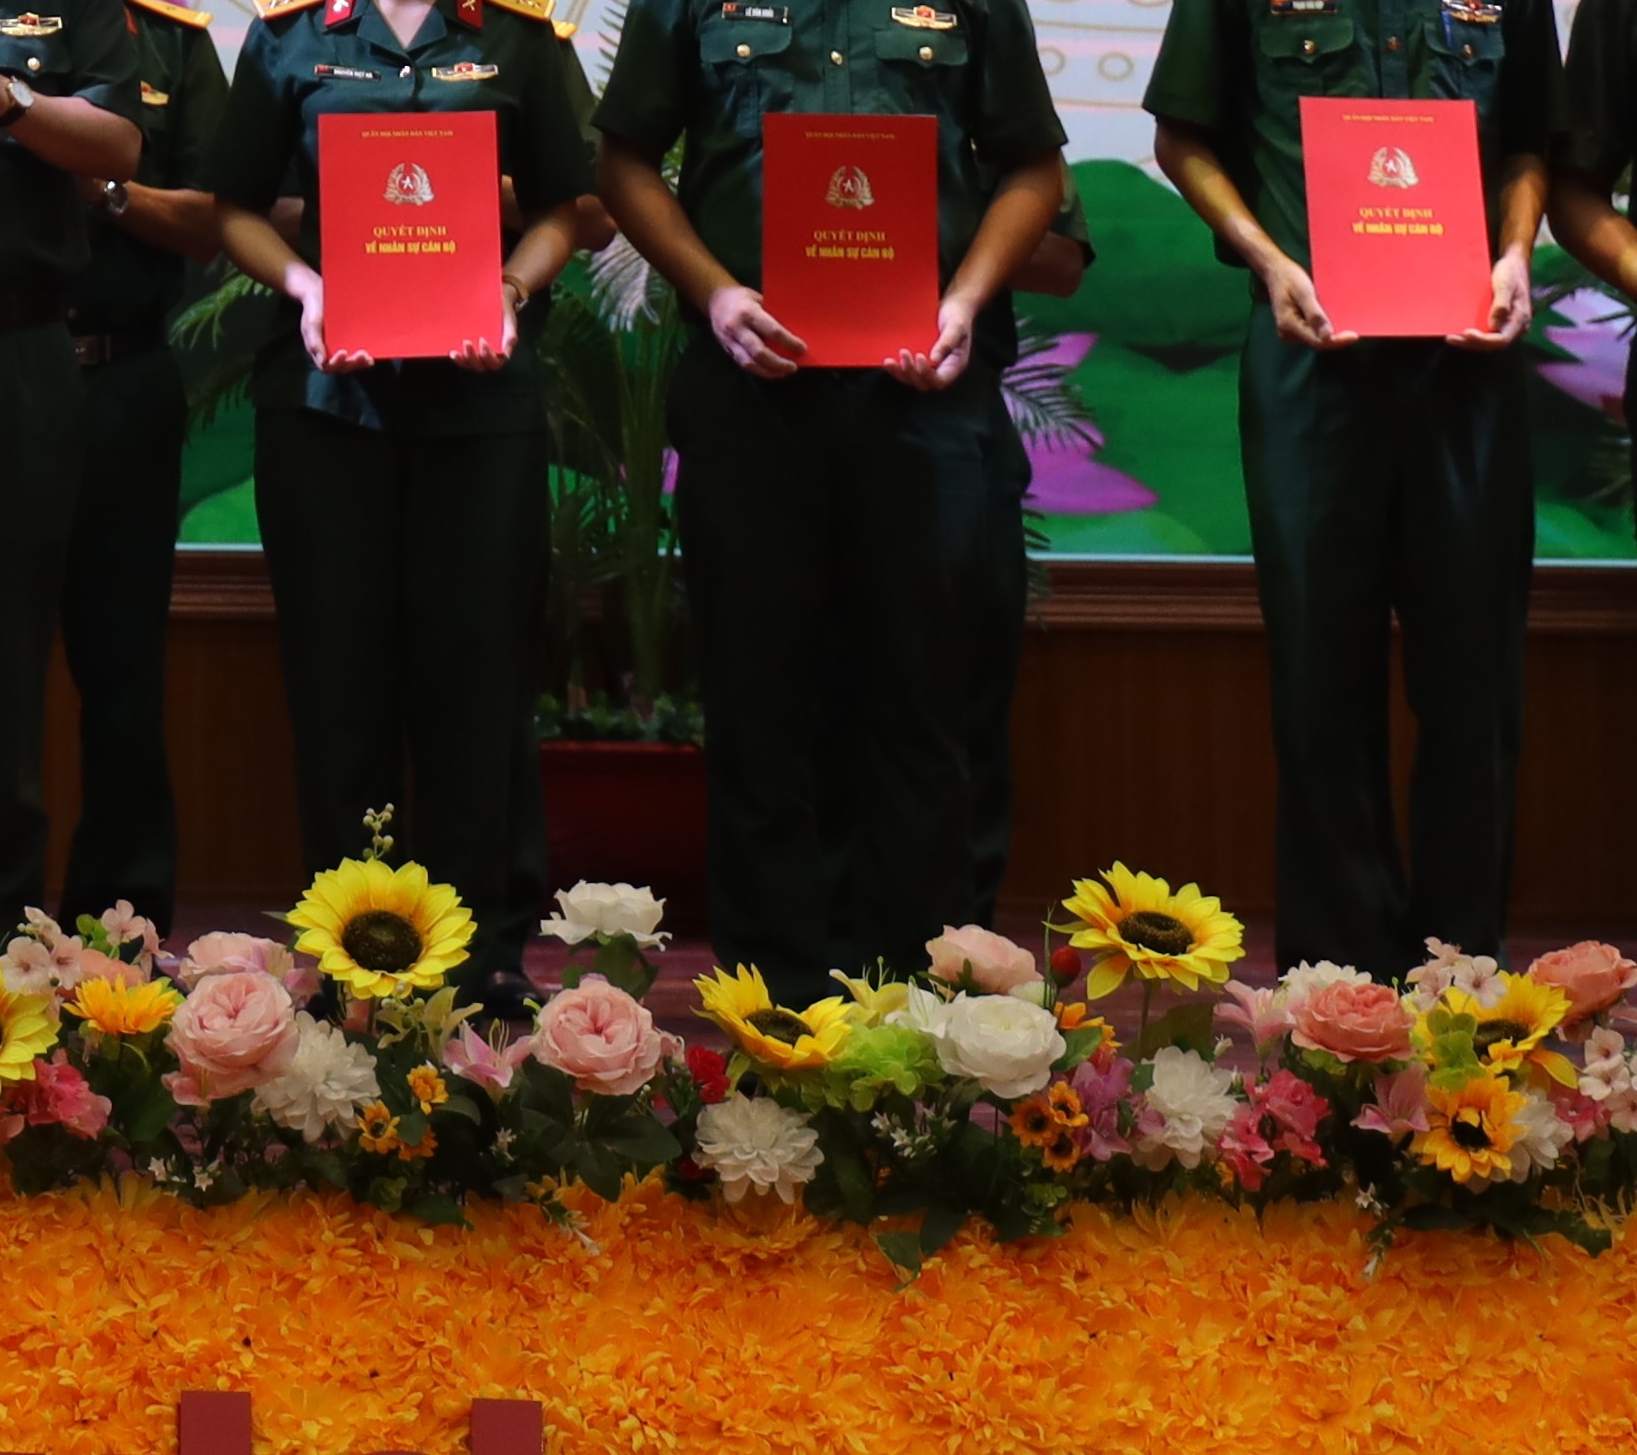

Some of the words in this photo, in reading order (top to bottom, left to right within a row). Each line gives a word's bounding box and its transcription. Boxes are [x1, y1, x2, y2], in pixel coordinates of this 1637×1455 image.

[373, 225, 415, 238] QUYẾT
[417, 226, 446, 237] ĐỊNH
[379, 242, 405, 253] NHÂN
[421, 241, 441, 252] CÁN
[443, 241, 455, 253] BỘ
